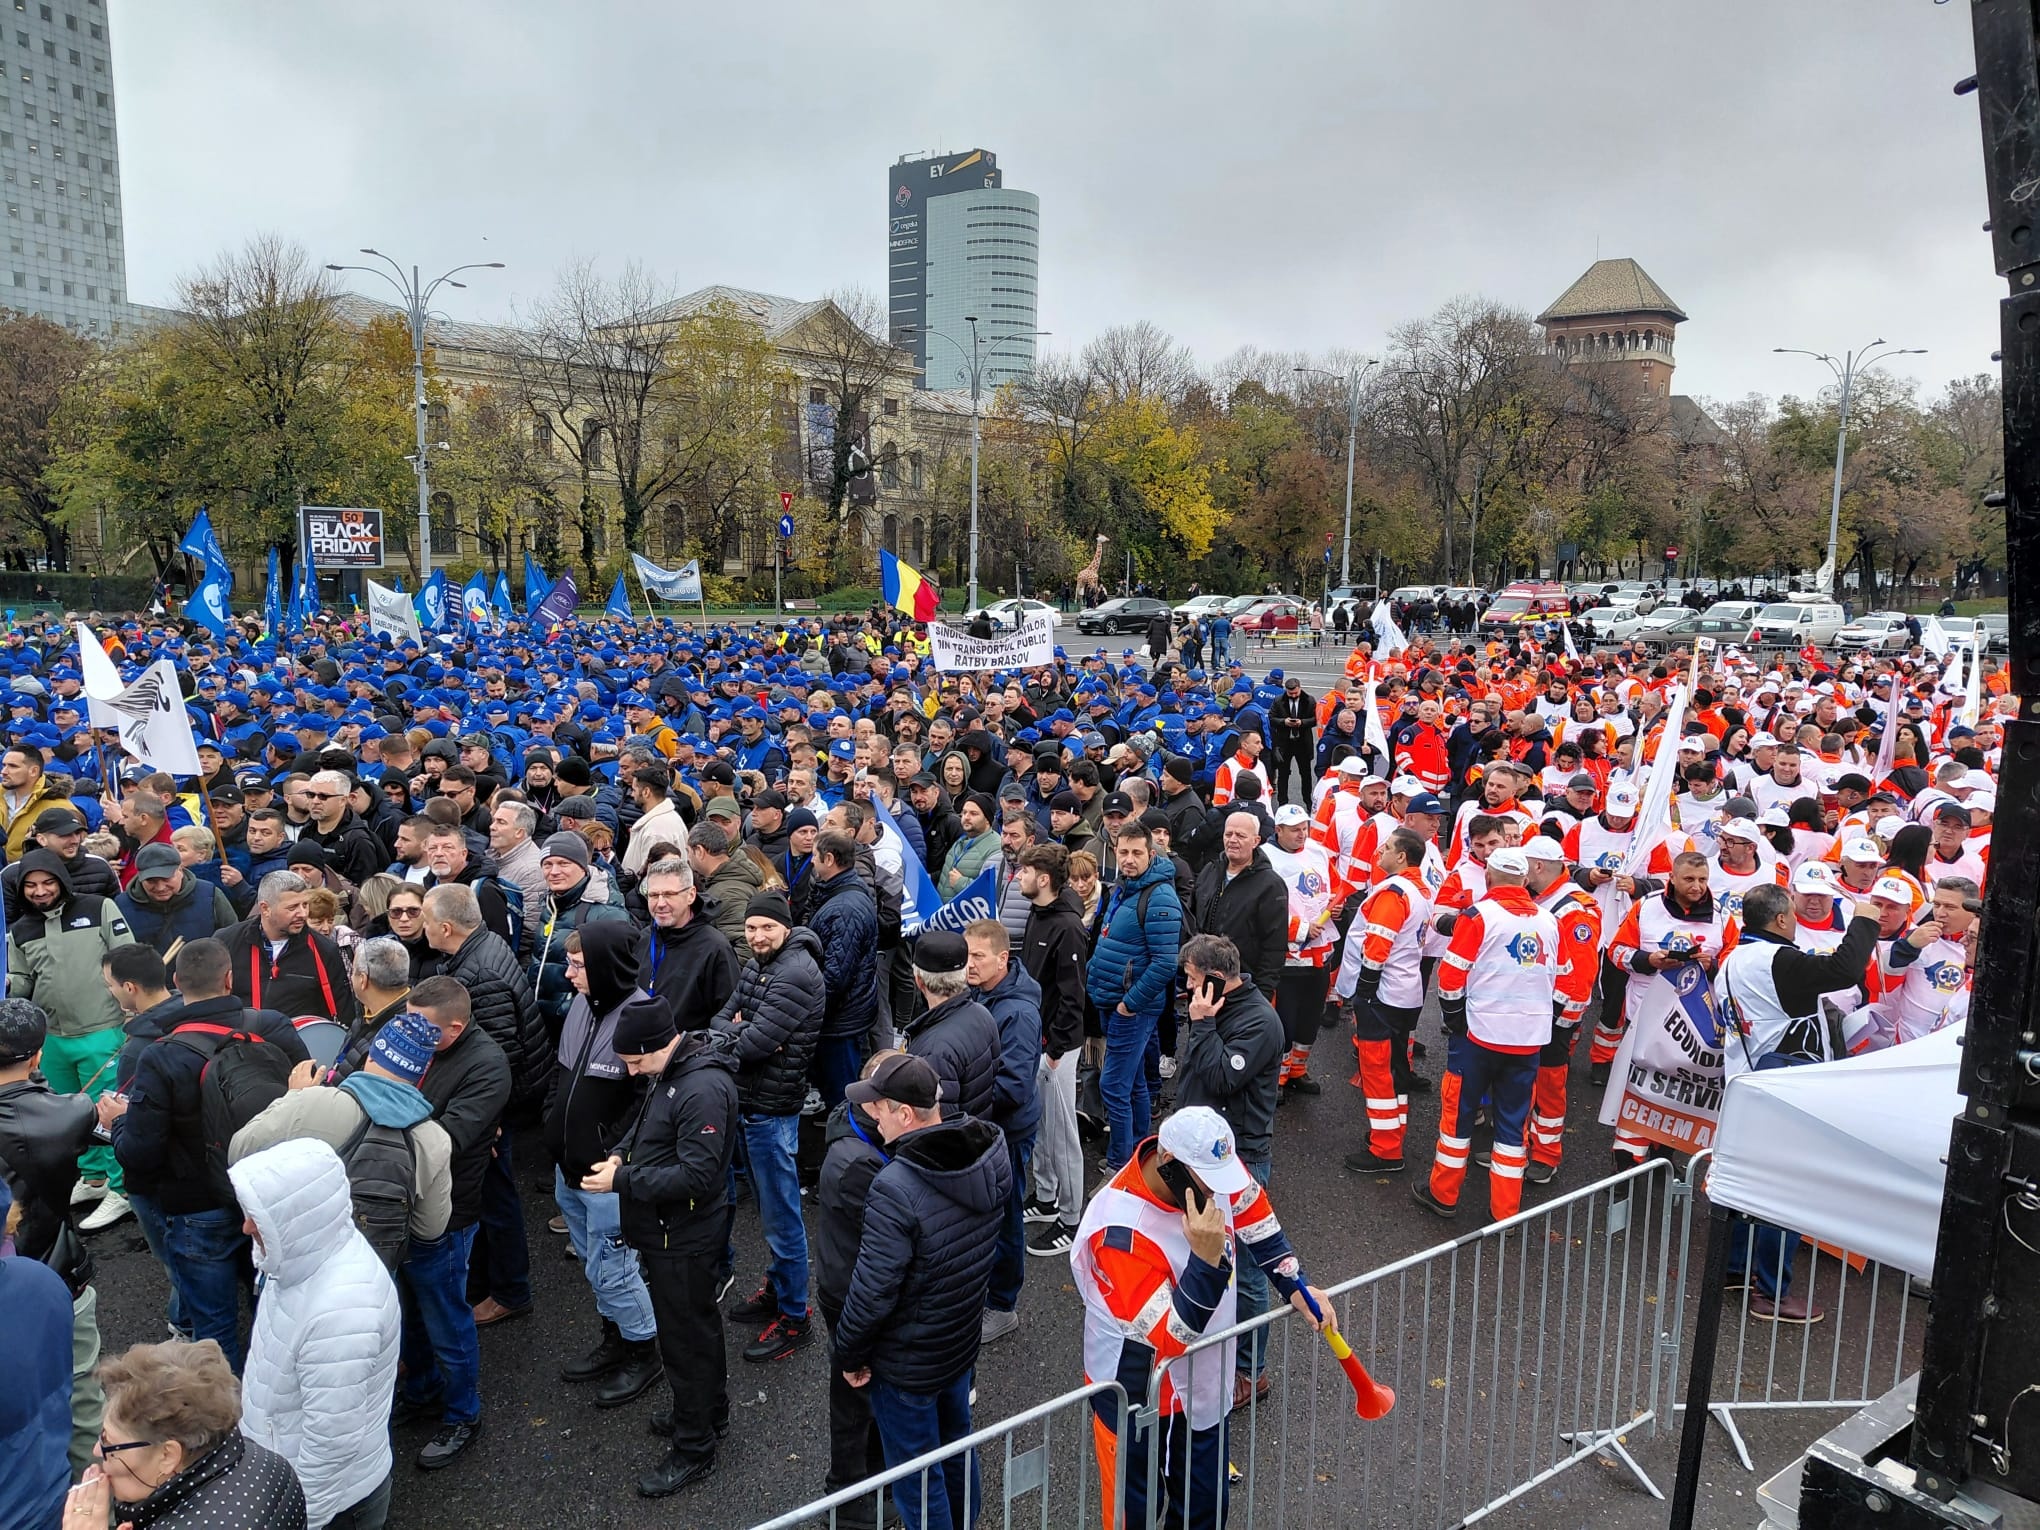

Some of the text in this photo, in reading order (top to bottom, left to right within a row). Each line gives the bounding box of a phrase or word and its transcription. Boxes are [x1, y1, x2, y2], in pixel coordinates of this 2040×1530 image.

[930, 163, 945, 179] EY
[984, 178, 993, 189] EY
[310, 521, 374, 538] BLACK
[310, 538, 373, 554] FRIDAY
[935, 618, 1046, 645] SINDICUL AIATILOR
[952, 642, 1015, 655] TRANSPORTUL
[1017, 633, 1047, 649] PUBLIC
[954, 651, 1030, 667] RATBV BRASOV
[589, 1062, 620, 1074] MONCLER
[1621, 1098, 1716, 1148] CEREM A
